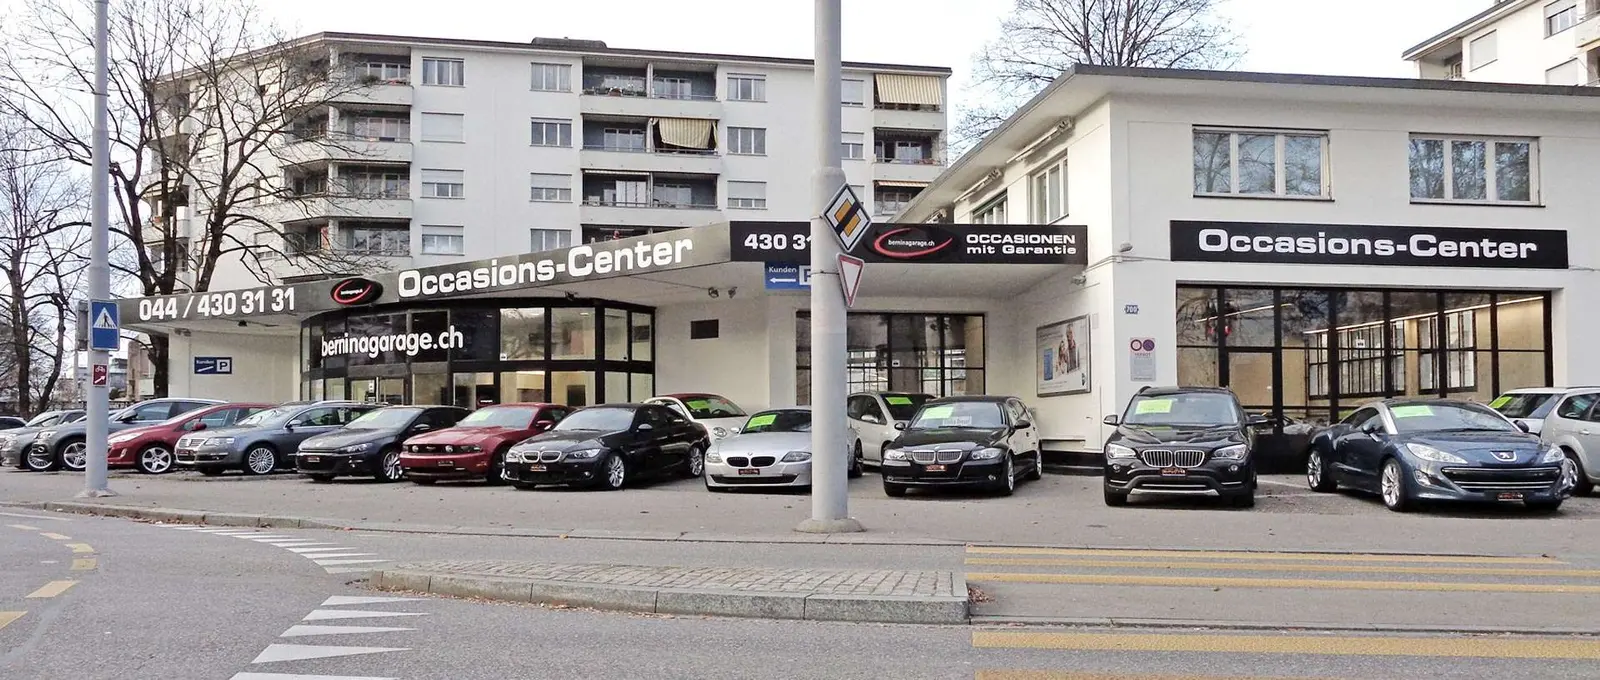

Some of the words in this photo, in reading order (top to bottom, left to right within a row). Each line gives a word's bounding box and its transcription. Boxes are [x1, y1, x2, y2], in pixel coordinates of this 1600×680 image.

[744, 233, 787, 250] 430
[888, 239, 935, 247] berninagarage.ch
[966, 234, 1076, 244] OCCASIONEN
[1198, 228, 1537, 259] Occasions-Center
[966, 245, 995, 254] mit
[1002, 245, 1077, 255] Garantie
[398, 238, 693, 297] Occasions-Center
[139, 298, 177, 321] 044
[197, 292, 237, 317] 430
[241, 290, 265, 314] 31
[271, 287, 295, 312] 31
[321, 325, 464, 358] berninagarage.ch
[219, 361, 228, 370] P
